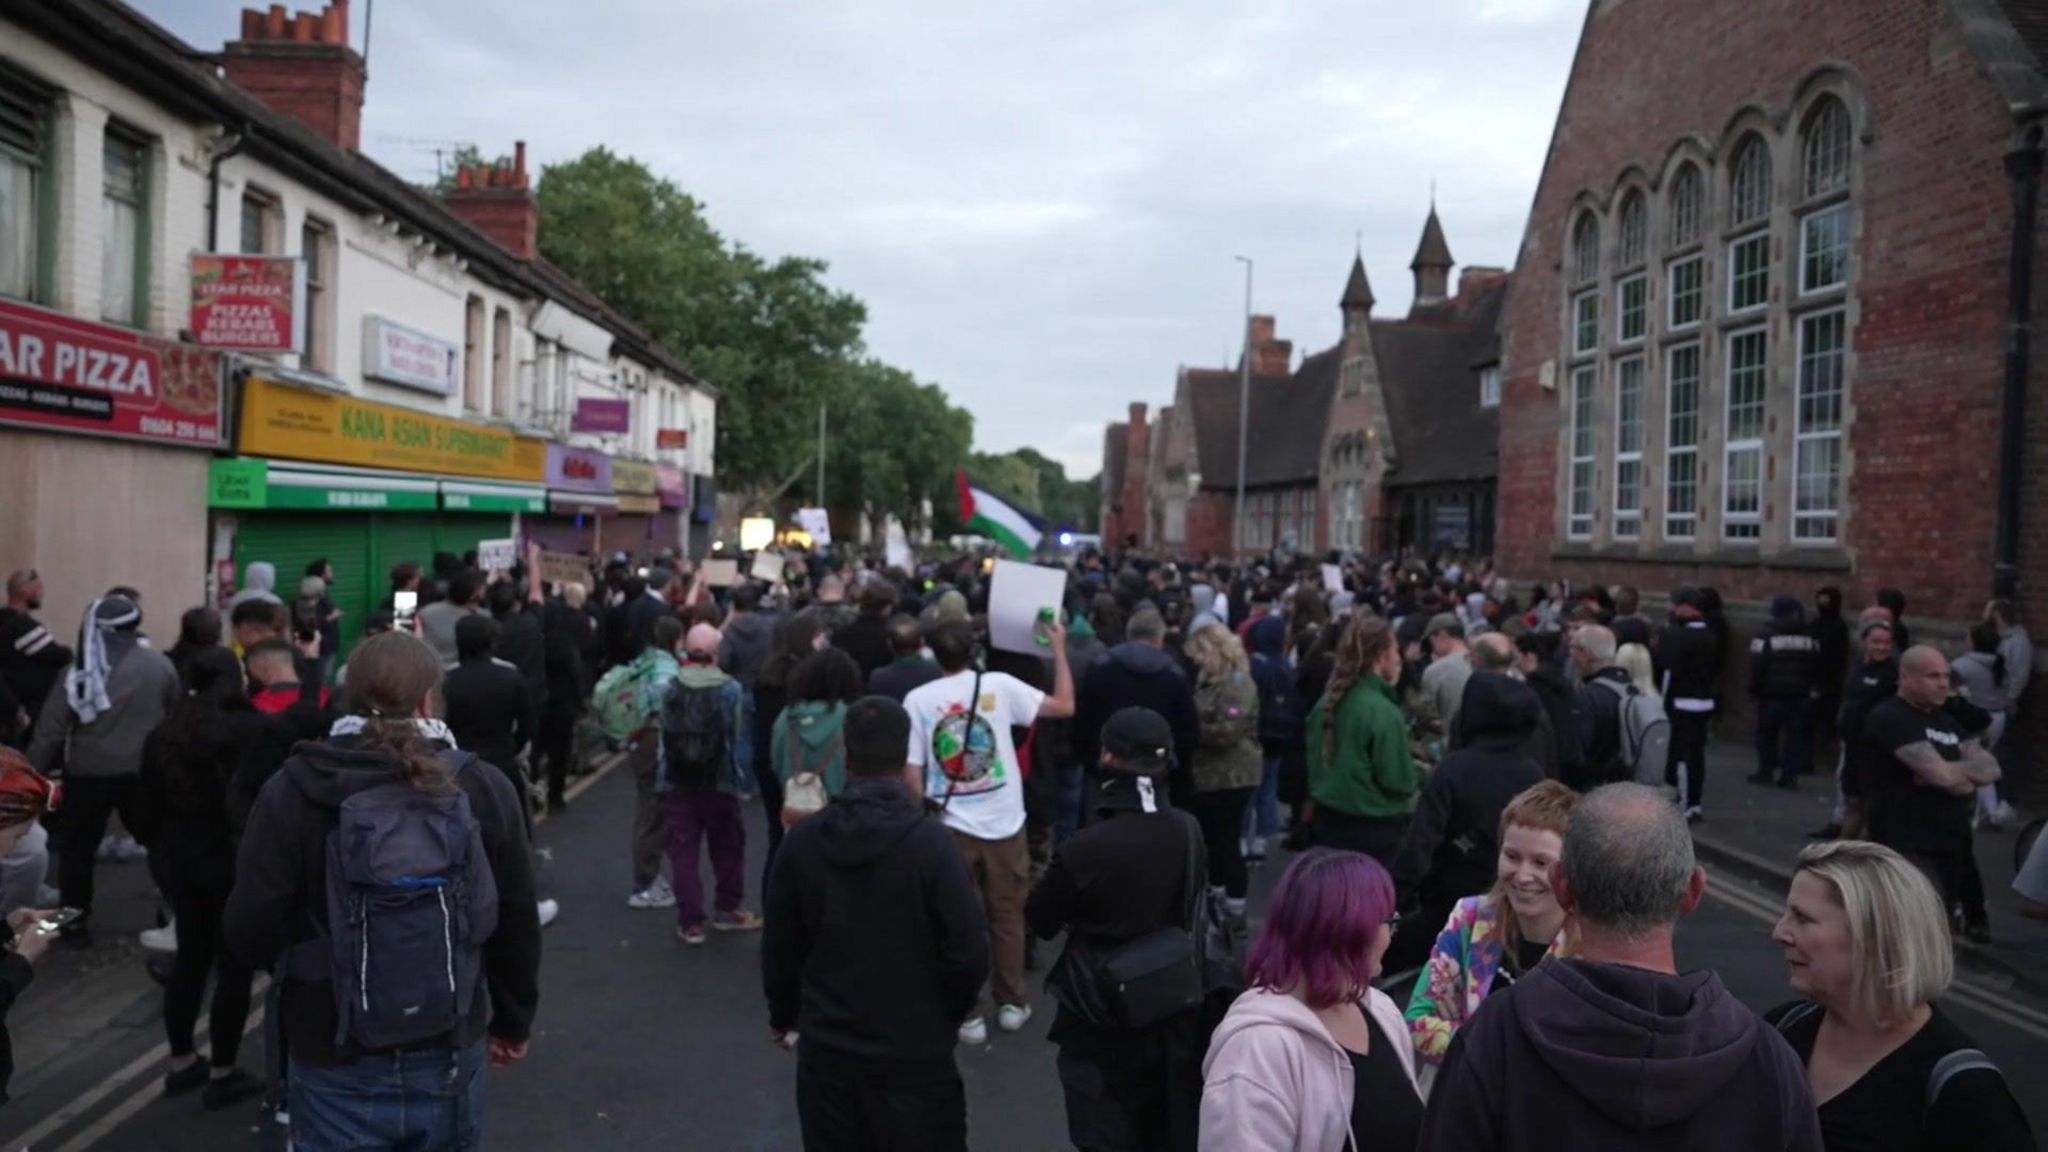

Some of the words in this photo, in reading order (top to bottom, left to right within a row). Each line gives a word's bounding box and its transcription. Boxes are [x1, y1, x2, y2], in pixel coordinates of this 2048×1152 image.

[240, 284, 282, 297] PIZZA
[211, 304, 271, 317] PIZZAS
[206, 318, 275, 330] KEBABS
[201, 330, 280, 344] BURGERS
[55, 343, 153, 396] PIZZA
[341, 405, 386, 441] KANA
[391, 413, 432, 447] ASIAN
[435, 424, 511, 459] SUPERMARKET
[218, 473, 249, 486] Uber
[218, 487, 250, 500] Eats
